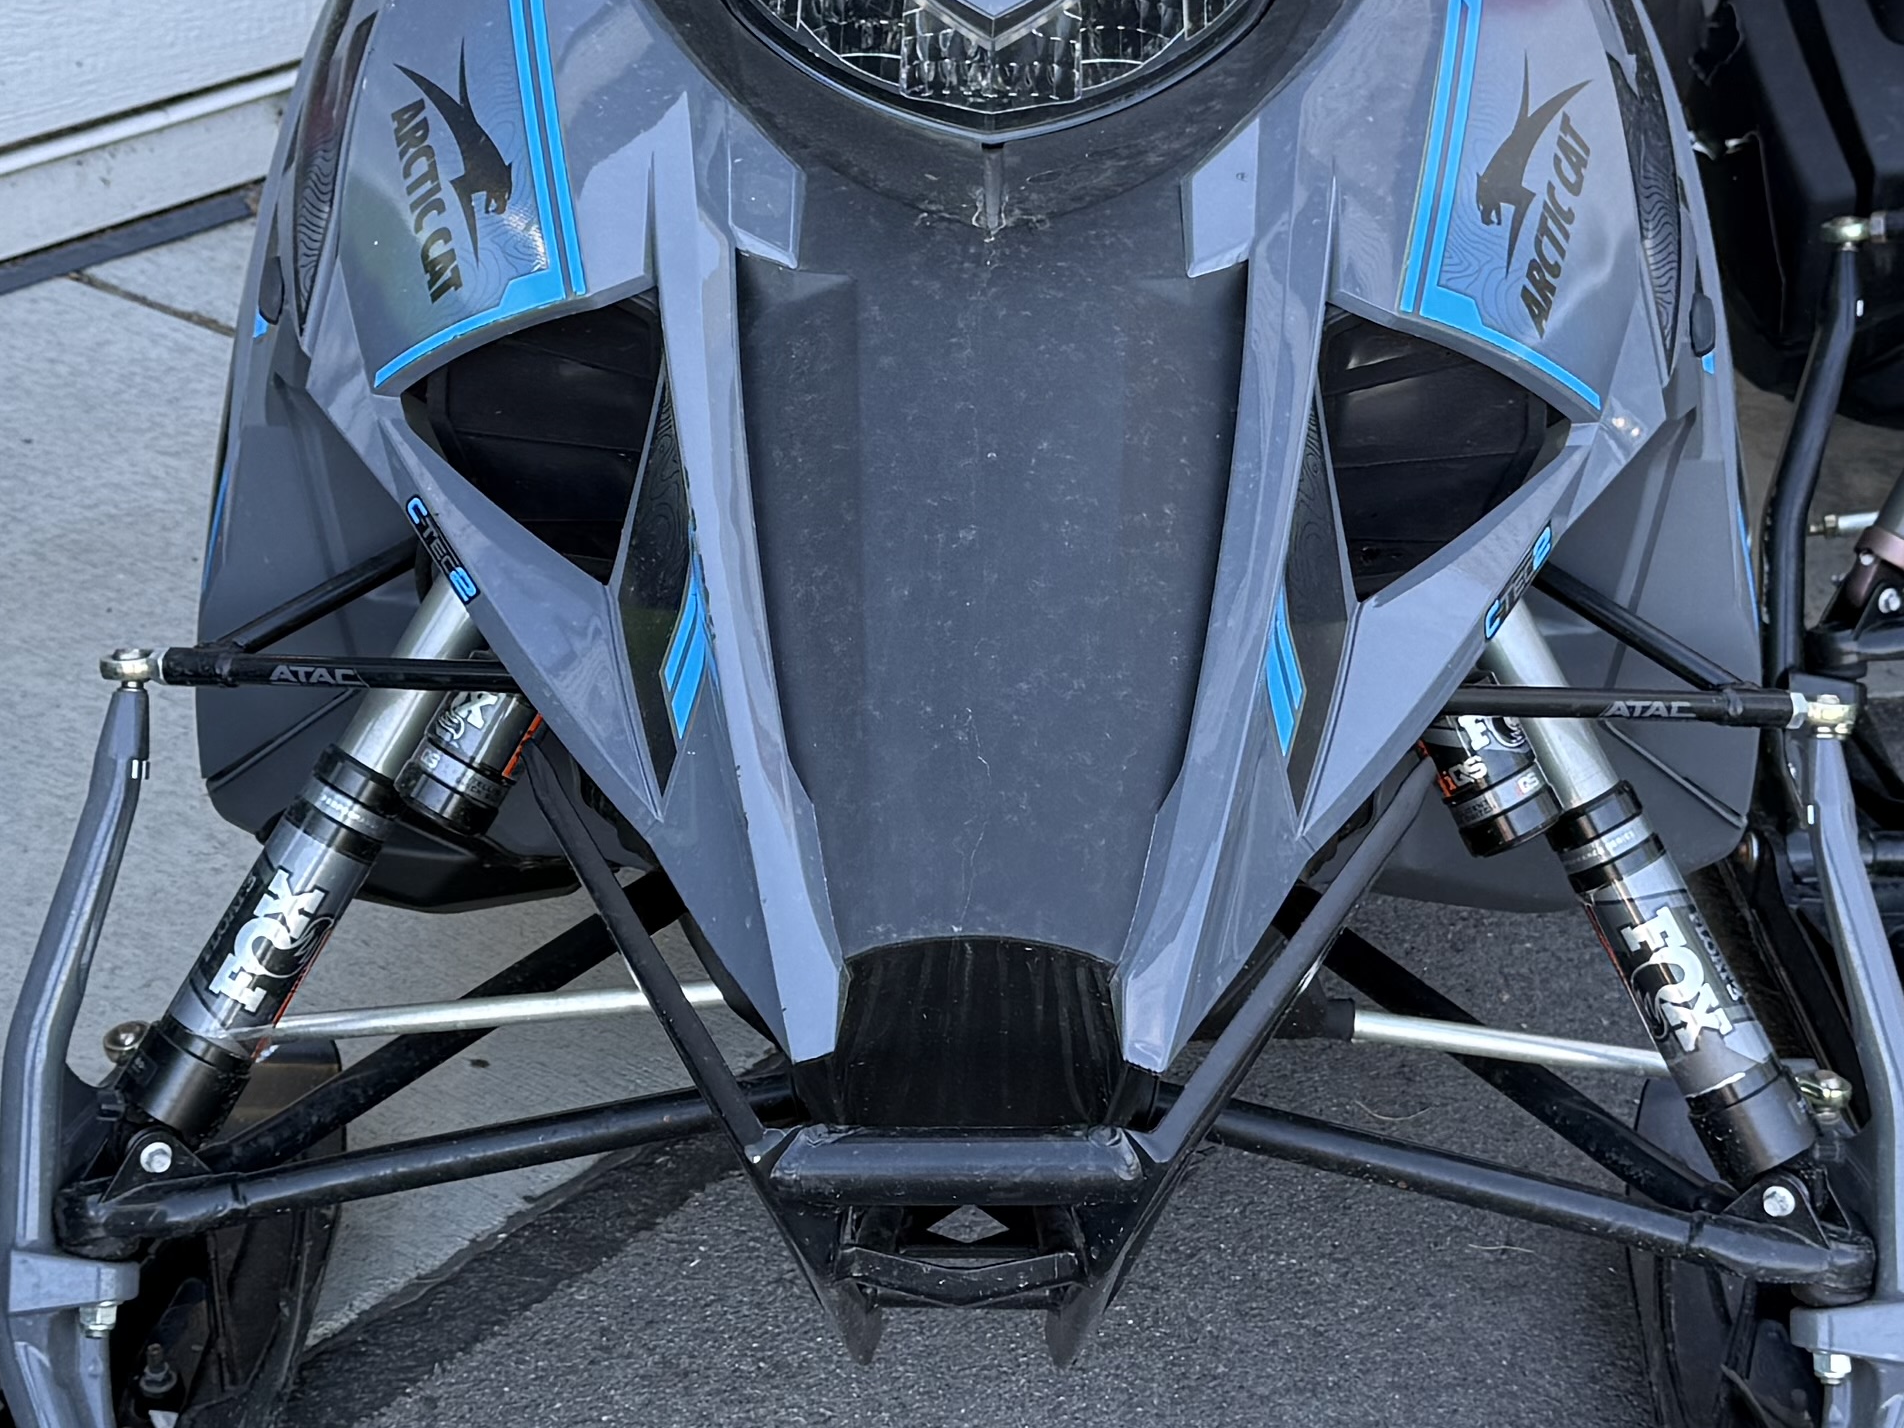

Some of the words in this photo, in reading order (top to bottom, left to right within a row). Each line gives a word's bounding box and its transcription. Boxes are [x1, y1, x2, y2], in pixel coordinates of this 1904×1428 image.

[391, 98, 446, 235] ARCTIC
[420, 227, 463, 304] CAT
[1520, 180, 1576, 340] ARCTIC
[1553, 111, 1591, 197] CAT
[269, 664, 364, 686] ATAC
[1602, 700, 1696, 718] ATAC
[208, 866, 335, 1014] FOX
[1620, 905, 1734, 1053] FOX
